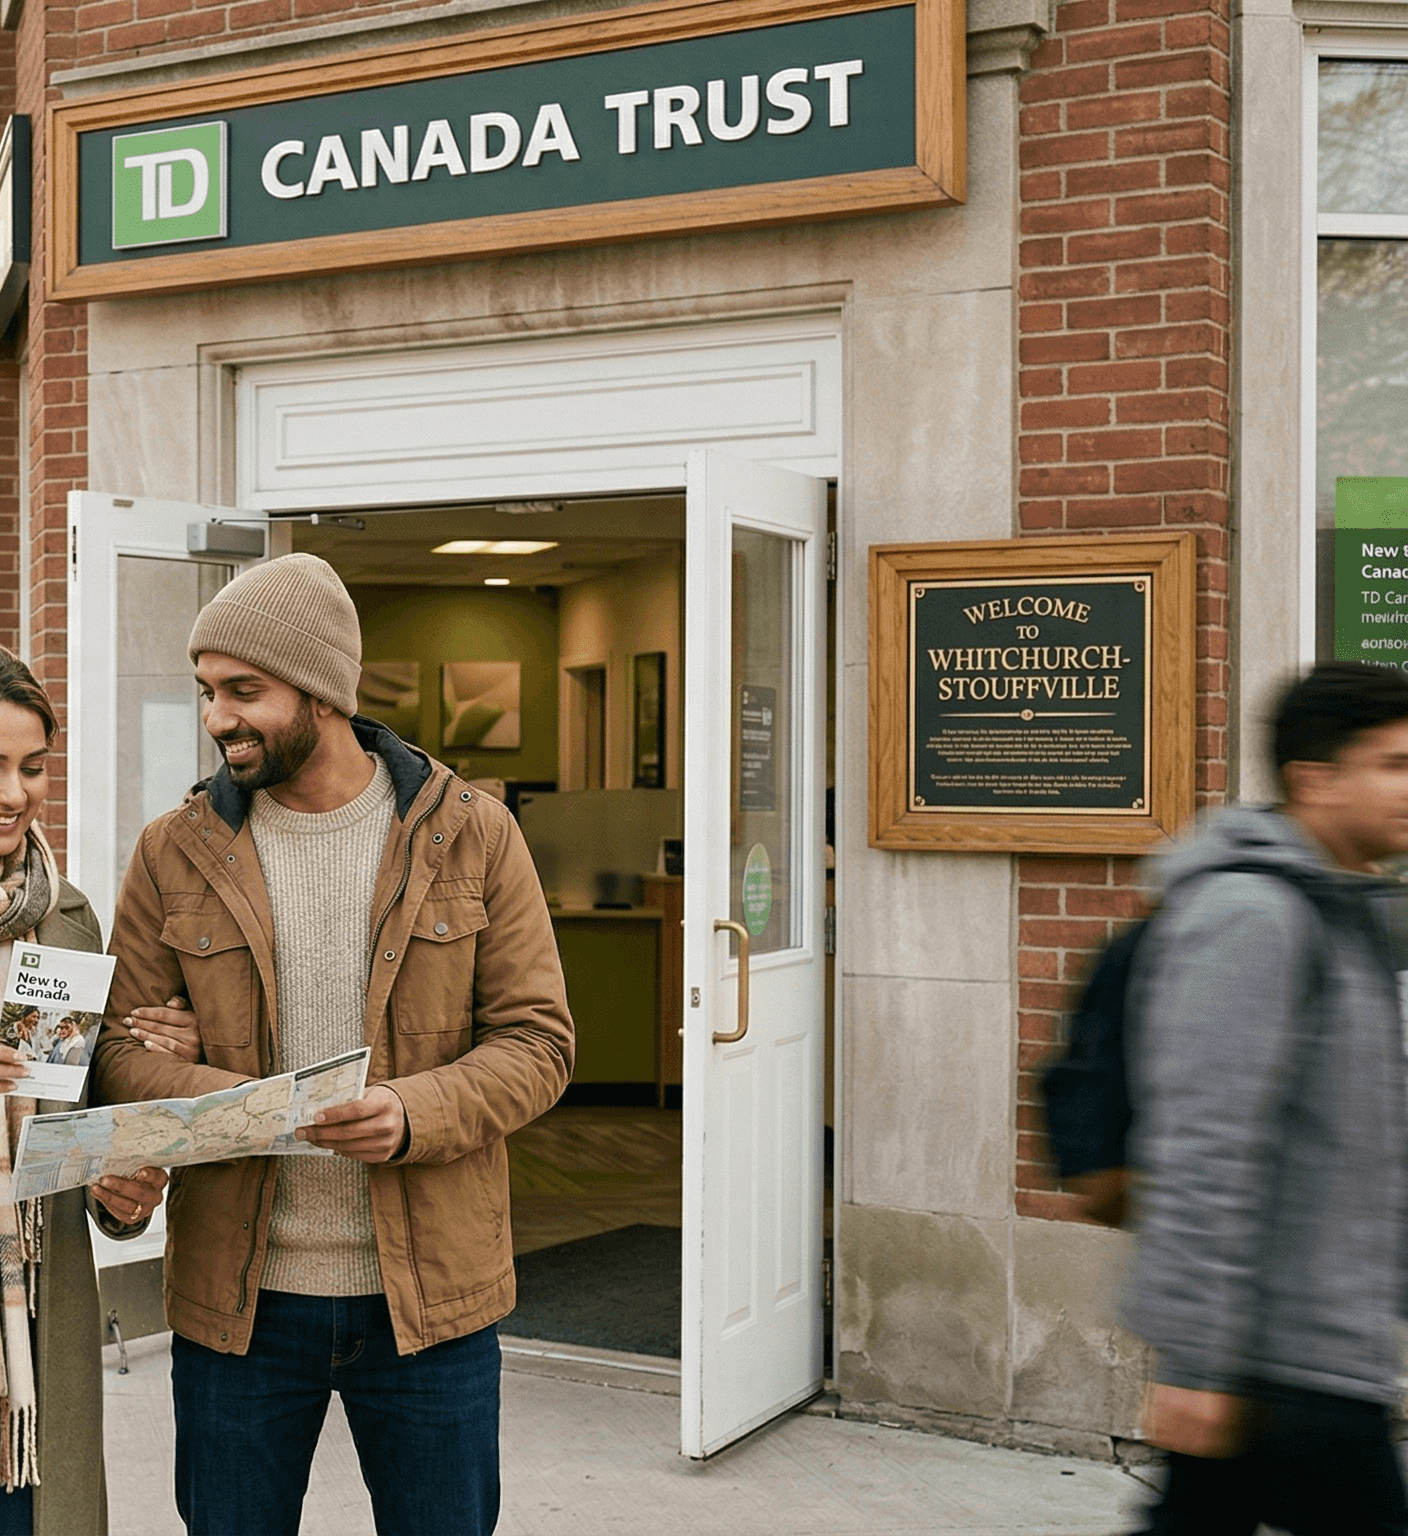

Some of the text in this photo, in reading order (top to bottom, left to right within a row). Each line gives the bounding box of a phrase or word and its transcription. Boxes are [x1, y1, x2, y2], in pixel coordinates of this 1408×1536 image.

[123, 59, 865, 222] TD CANADA TRUST
[1361, 543, 1399, 557] New
[1361, 591, 1381, 604] TD
[963, 596, 1091, 625] WELCOME
[1016, 625, 1039, 640] TO
[928, 646, 1131, 671] WHITCHURCH-
[939, 676, 1121, 700] STOUFFVILLE
[17, 972, 67, 989] New to
[16, 985, 70, 1001] Canada
